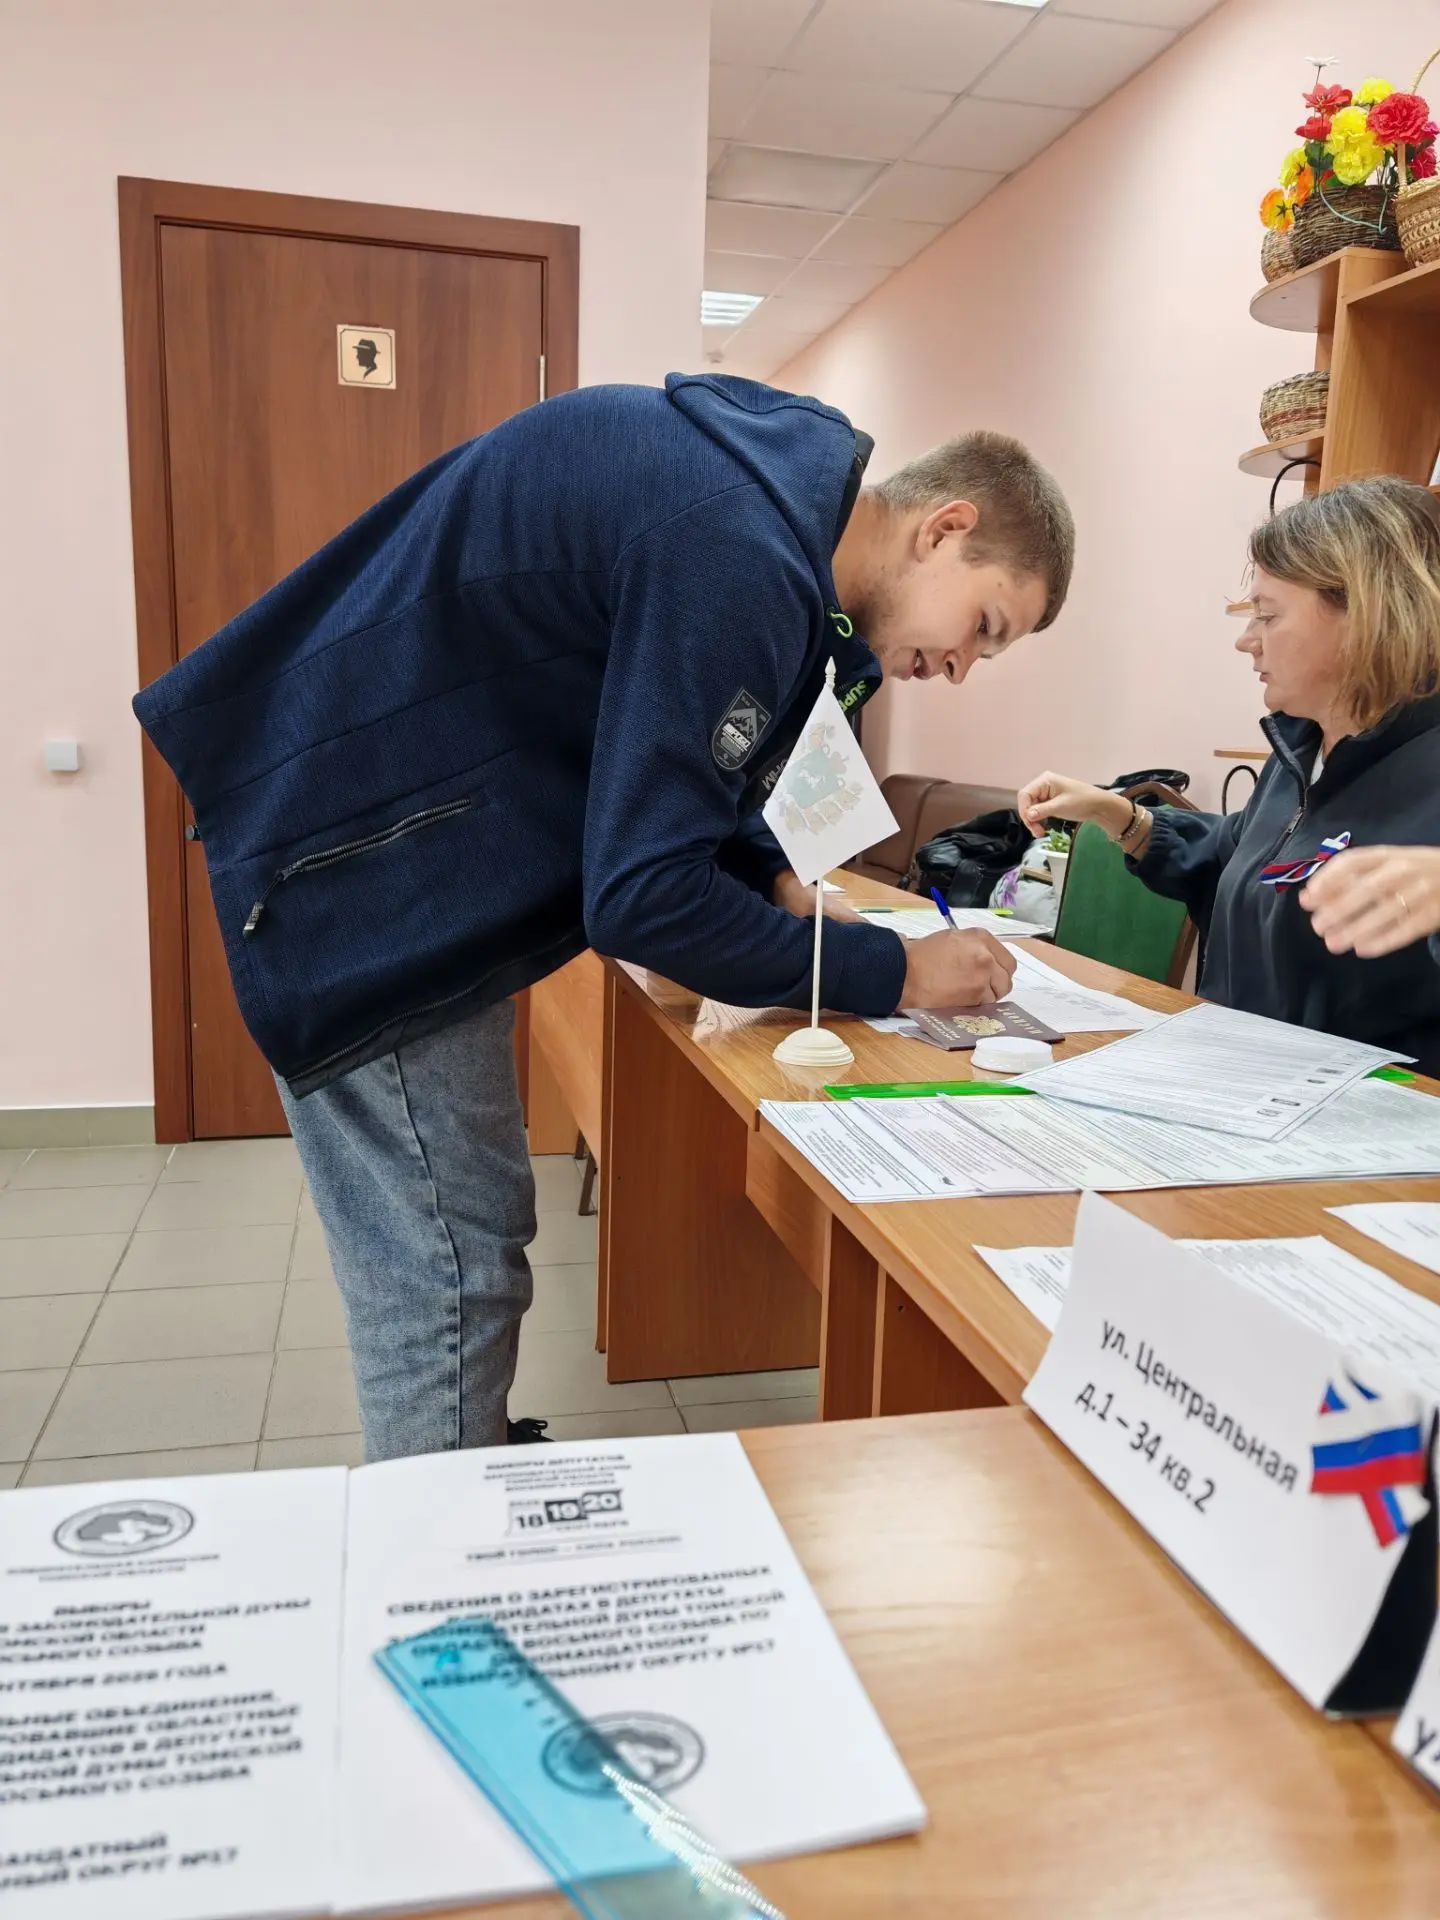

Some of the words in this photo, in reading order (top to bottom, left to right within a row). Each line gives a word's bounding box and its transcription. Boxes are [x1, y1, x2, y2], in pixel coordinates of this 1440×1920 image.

[1100, 1320, 1129, 1359] ул.
[1136, 1341, 1299, 1493] Центральная
[1075, 1382, 1114, 1422] д.1
[1130, 1421, 1163, 1463] 34
[1160, 1454, 1215, 1514] кв.2
[517, 1513, 544, 1529] 18
[549, 1502, 580, 1521] 19
[583, 1492, 620, 1510] 20
[386, 1595, 502, 1616] СВЕДЕНИЯ
[508, 1592, 522, 1603] О
[616, 1586, 725, 1609] ДЕПУТАТЫ
[616, 1606, 679, 1624] ДУМЫ
[164, 1662, 227, 1680] ГОДА
[153, 1725, 291, 1752] ДЕПУТАТЫ
[85, 1757, 166, 1778] ДУМЫ
